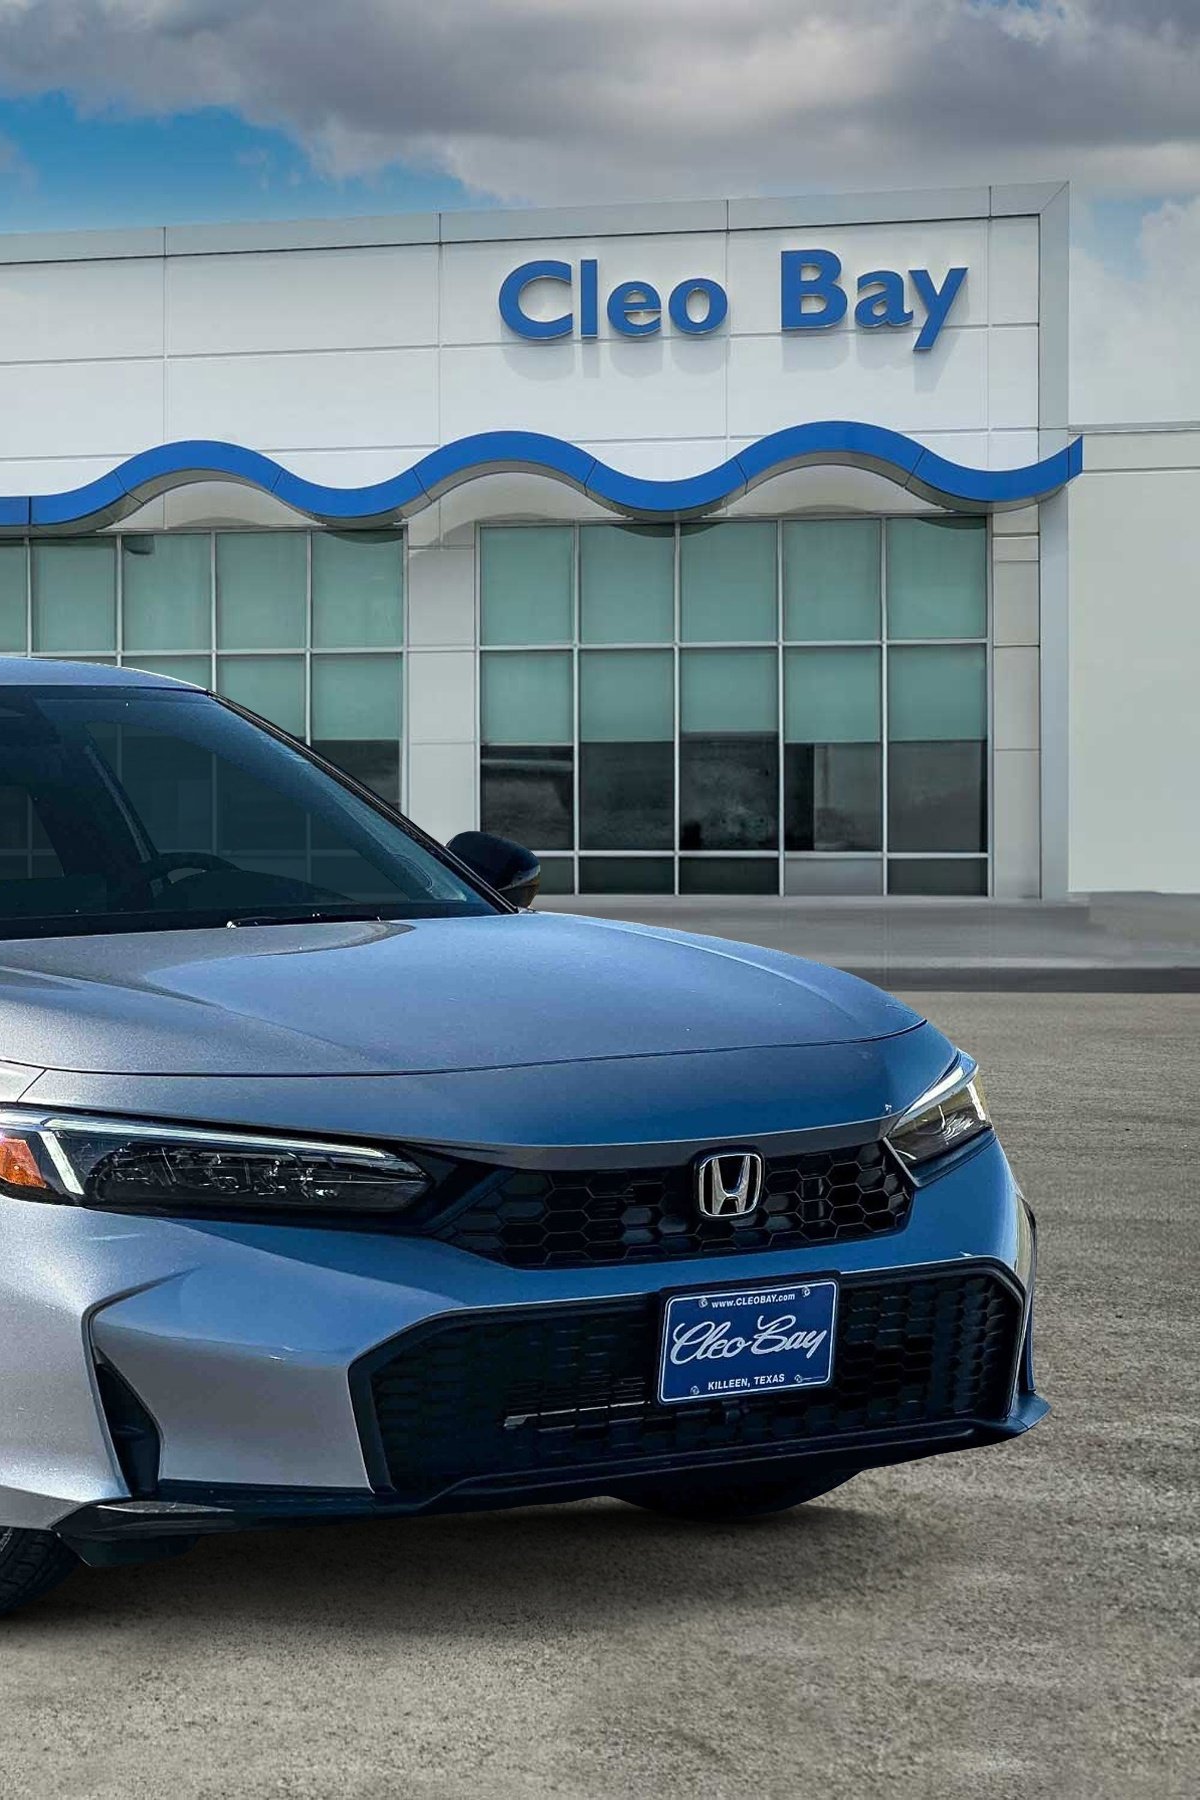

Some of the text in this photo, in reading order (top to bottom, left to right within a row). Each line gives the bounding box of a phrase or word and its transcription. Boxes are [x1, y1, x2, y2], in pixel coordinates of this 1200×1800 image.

[499, 249, 969, 351] Cleo Bay
[711, 1293, 795, 1309] www.CLEOBAY.com
[670, 1315, 827, 1365] Cleo Bay
[708, 1374, 785, 1391] KILLEEN, TEXAS
